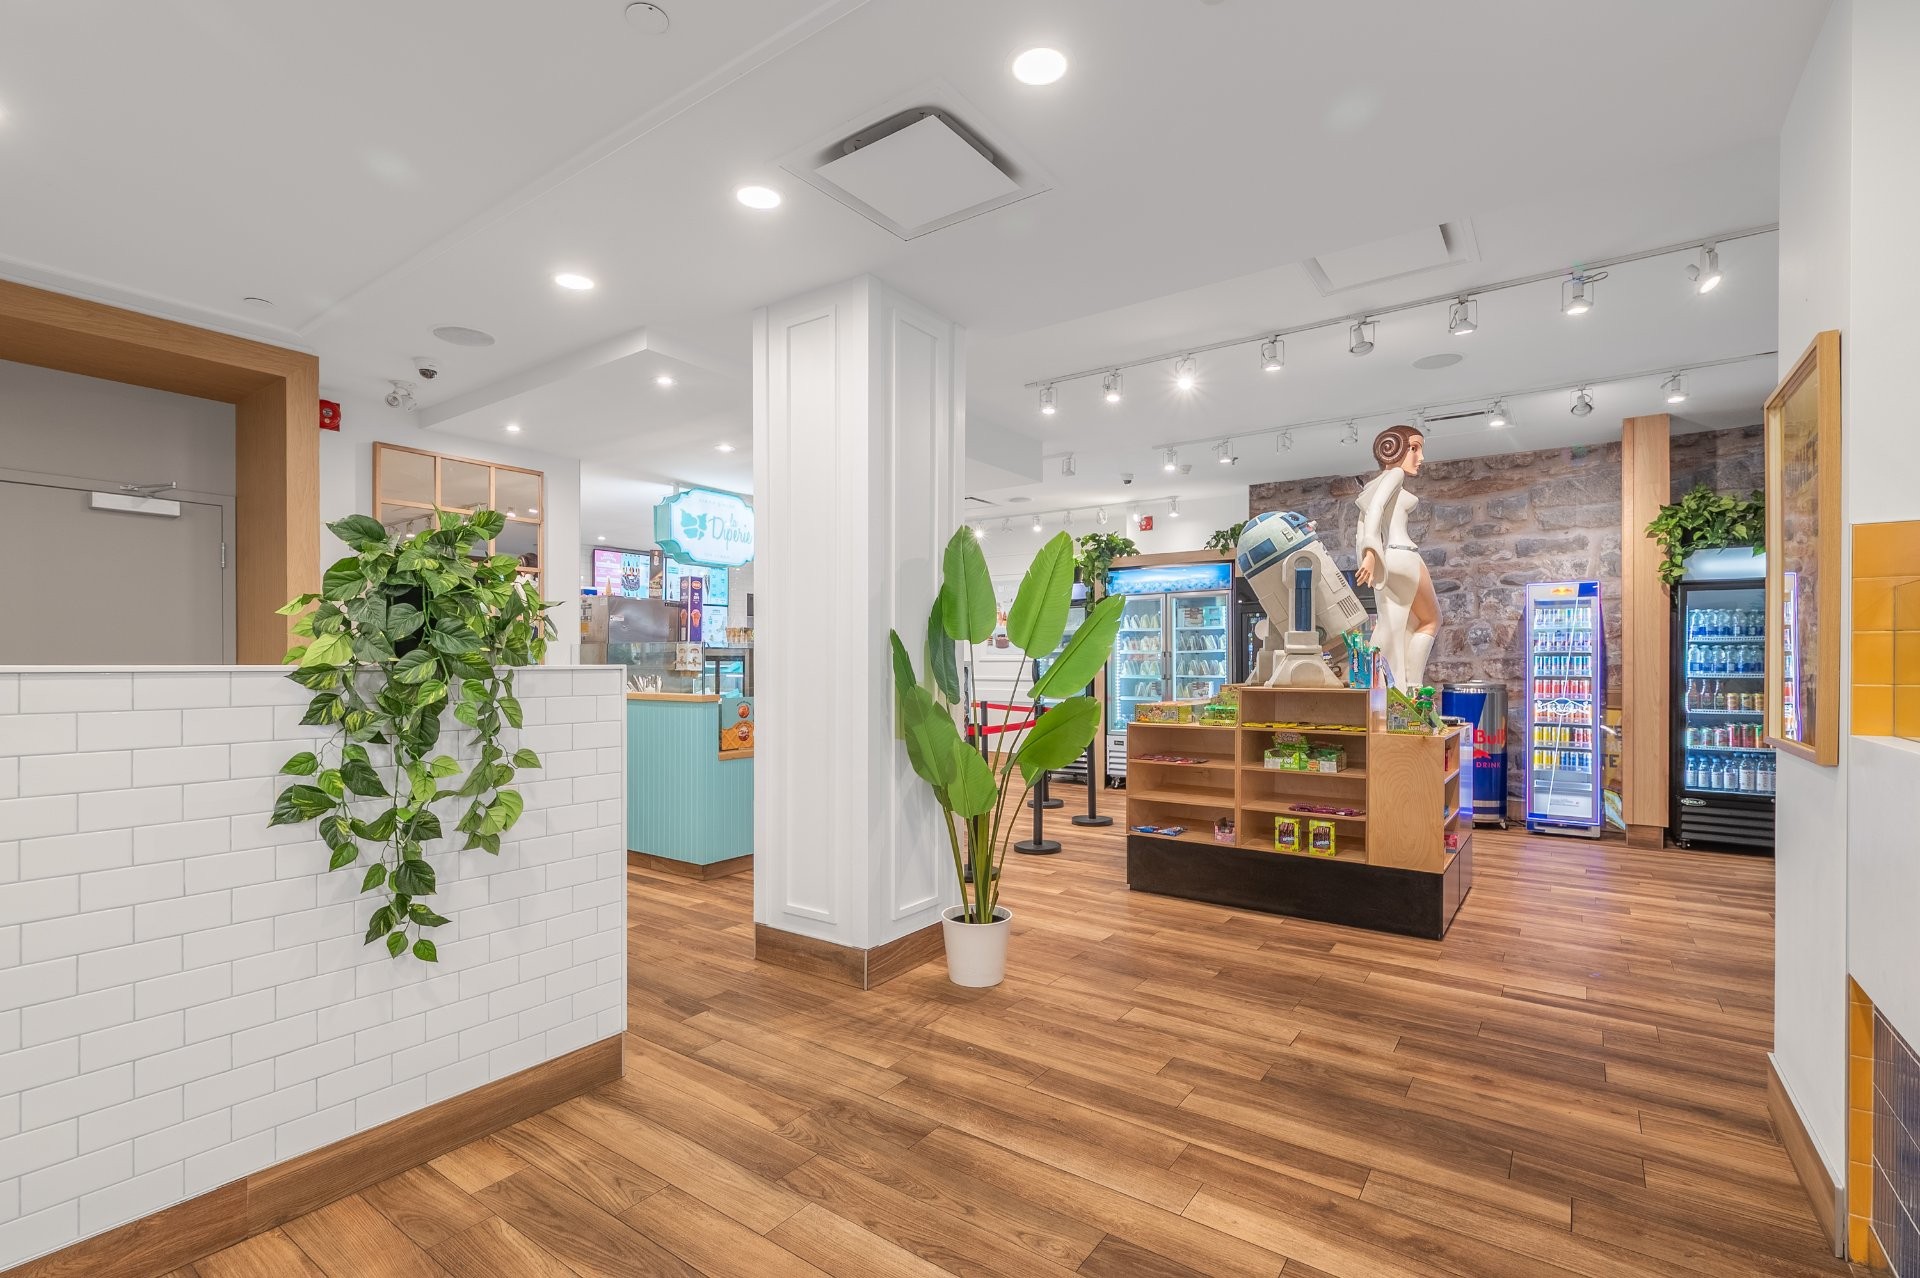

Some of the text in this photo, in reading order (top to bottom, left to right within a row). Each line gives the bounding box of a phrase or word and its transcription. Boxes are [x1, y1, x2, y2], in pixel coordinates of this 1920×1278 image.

[708, 516, 752, 551] Diperie
[1473, 729, 1505, 745] Bull
[1476, 761, 1501, 769] DRINK
